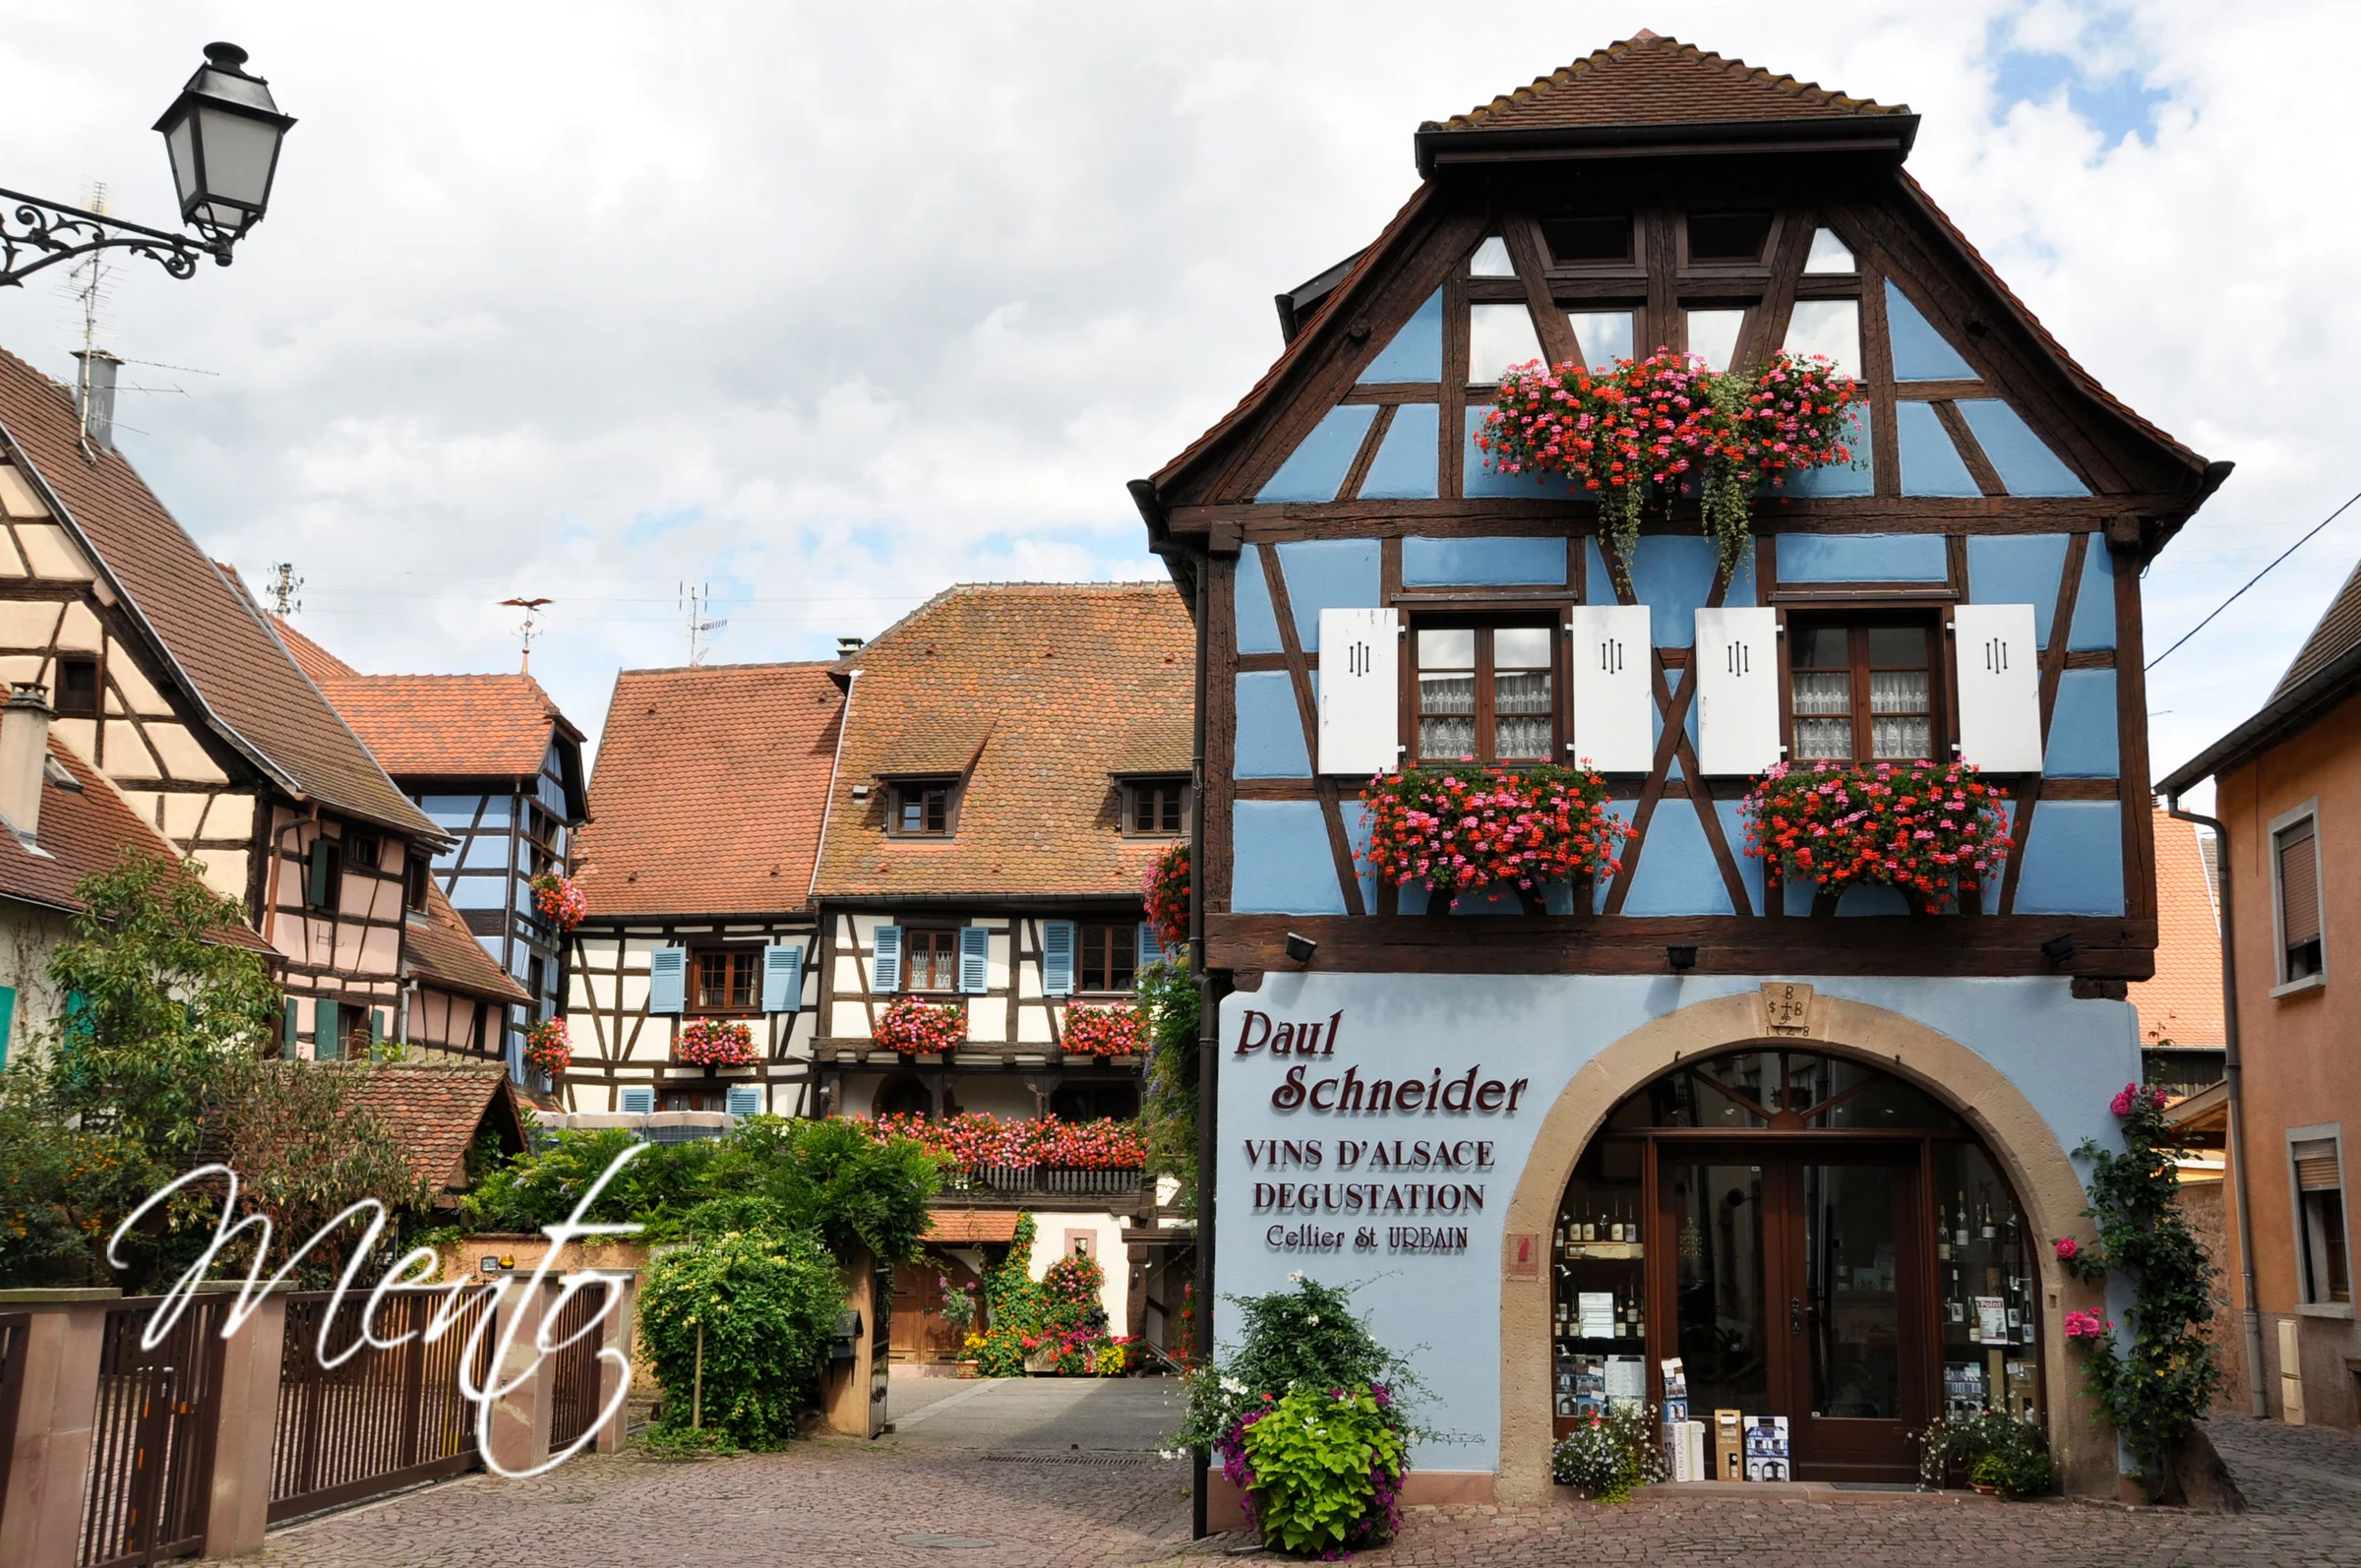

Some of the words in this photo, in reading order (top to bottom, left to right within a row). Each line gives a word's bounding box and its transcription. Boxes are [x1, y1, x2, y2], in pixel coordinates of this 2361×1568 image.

[1234, 1008, 1345, 1055] Paul
[1271, 1063, 1529, 1112] Schneider
[1243, 1139, 1323, 1166] VINS
[1337, 1140, 1495, 1167] D'ALSACE
[1252, 1182, 1486, 1210] DEGUSTATION
[1266, 1223, 1346, 1247] Cellier
[1354, 1226, 1379, 1248] St
[1388, 1226, 1469, 1248] URBAIN
